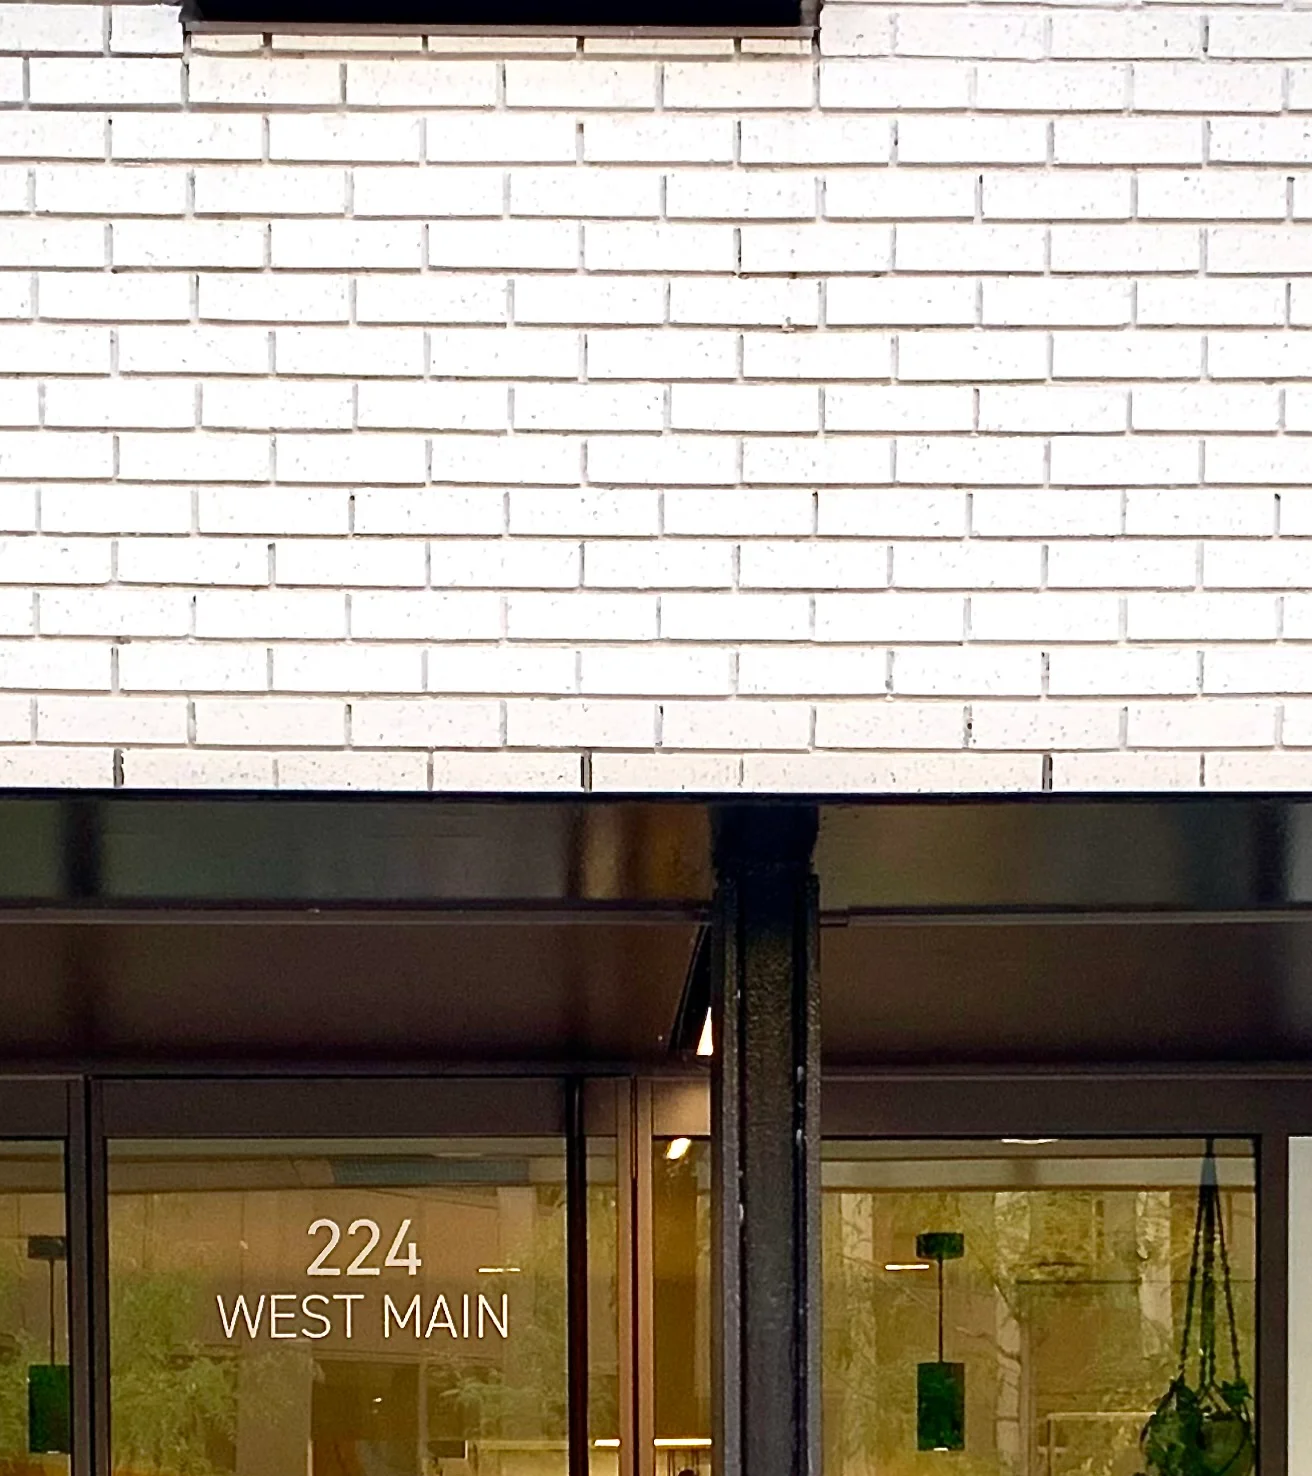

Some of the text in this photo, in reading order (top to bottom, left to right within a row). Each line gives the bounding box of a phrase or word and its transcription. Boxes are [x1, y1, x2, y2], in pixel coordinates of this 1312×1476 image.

[306, 1218, 422, 1276] 224
[216, 1294, 508, 1339] WEST MAIN
